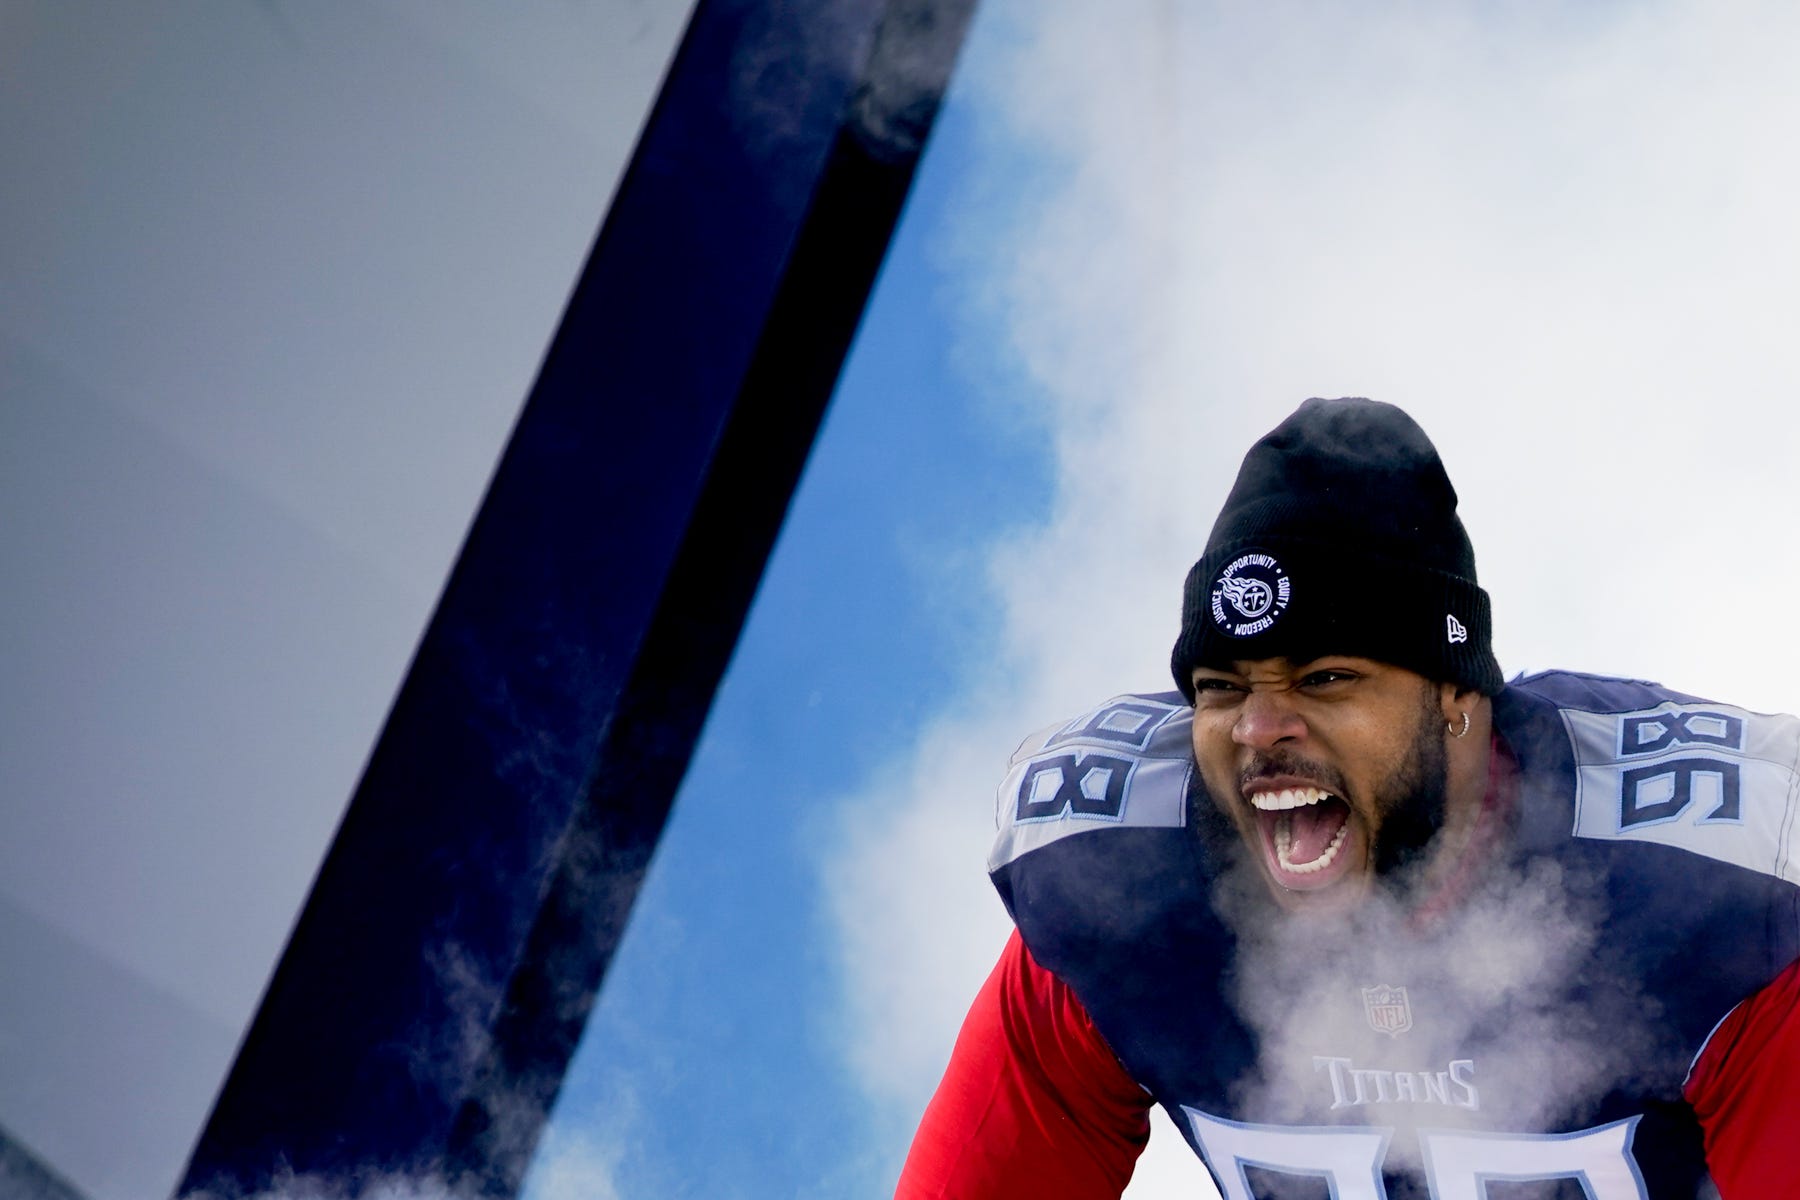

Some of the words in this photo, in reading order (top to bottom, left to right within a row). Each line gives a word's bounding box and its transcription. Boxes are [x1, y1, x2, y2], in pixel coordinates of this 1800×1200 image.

[1223, 555, 1276, 578] OPPORTUNITY
[1212, 590, 1227, 624] JUSTICE
[1278, 576, 1290, 609] EQUITY
[1235, 615, 1273, 636] FREEDOM
[1014, 700, 1183, 827] 98
[1616, 712, 1748, 833] 98
[1373, 1007, 1404, 1027] NFL
[1313, 1057, 1478, 1110] TITANS
